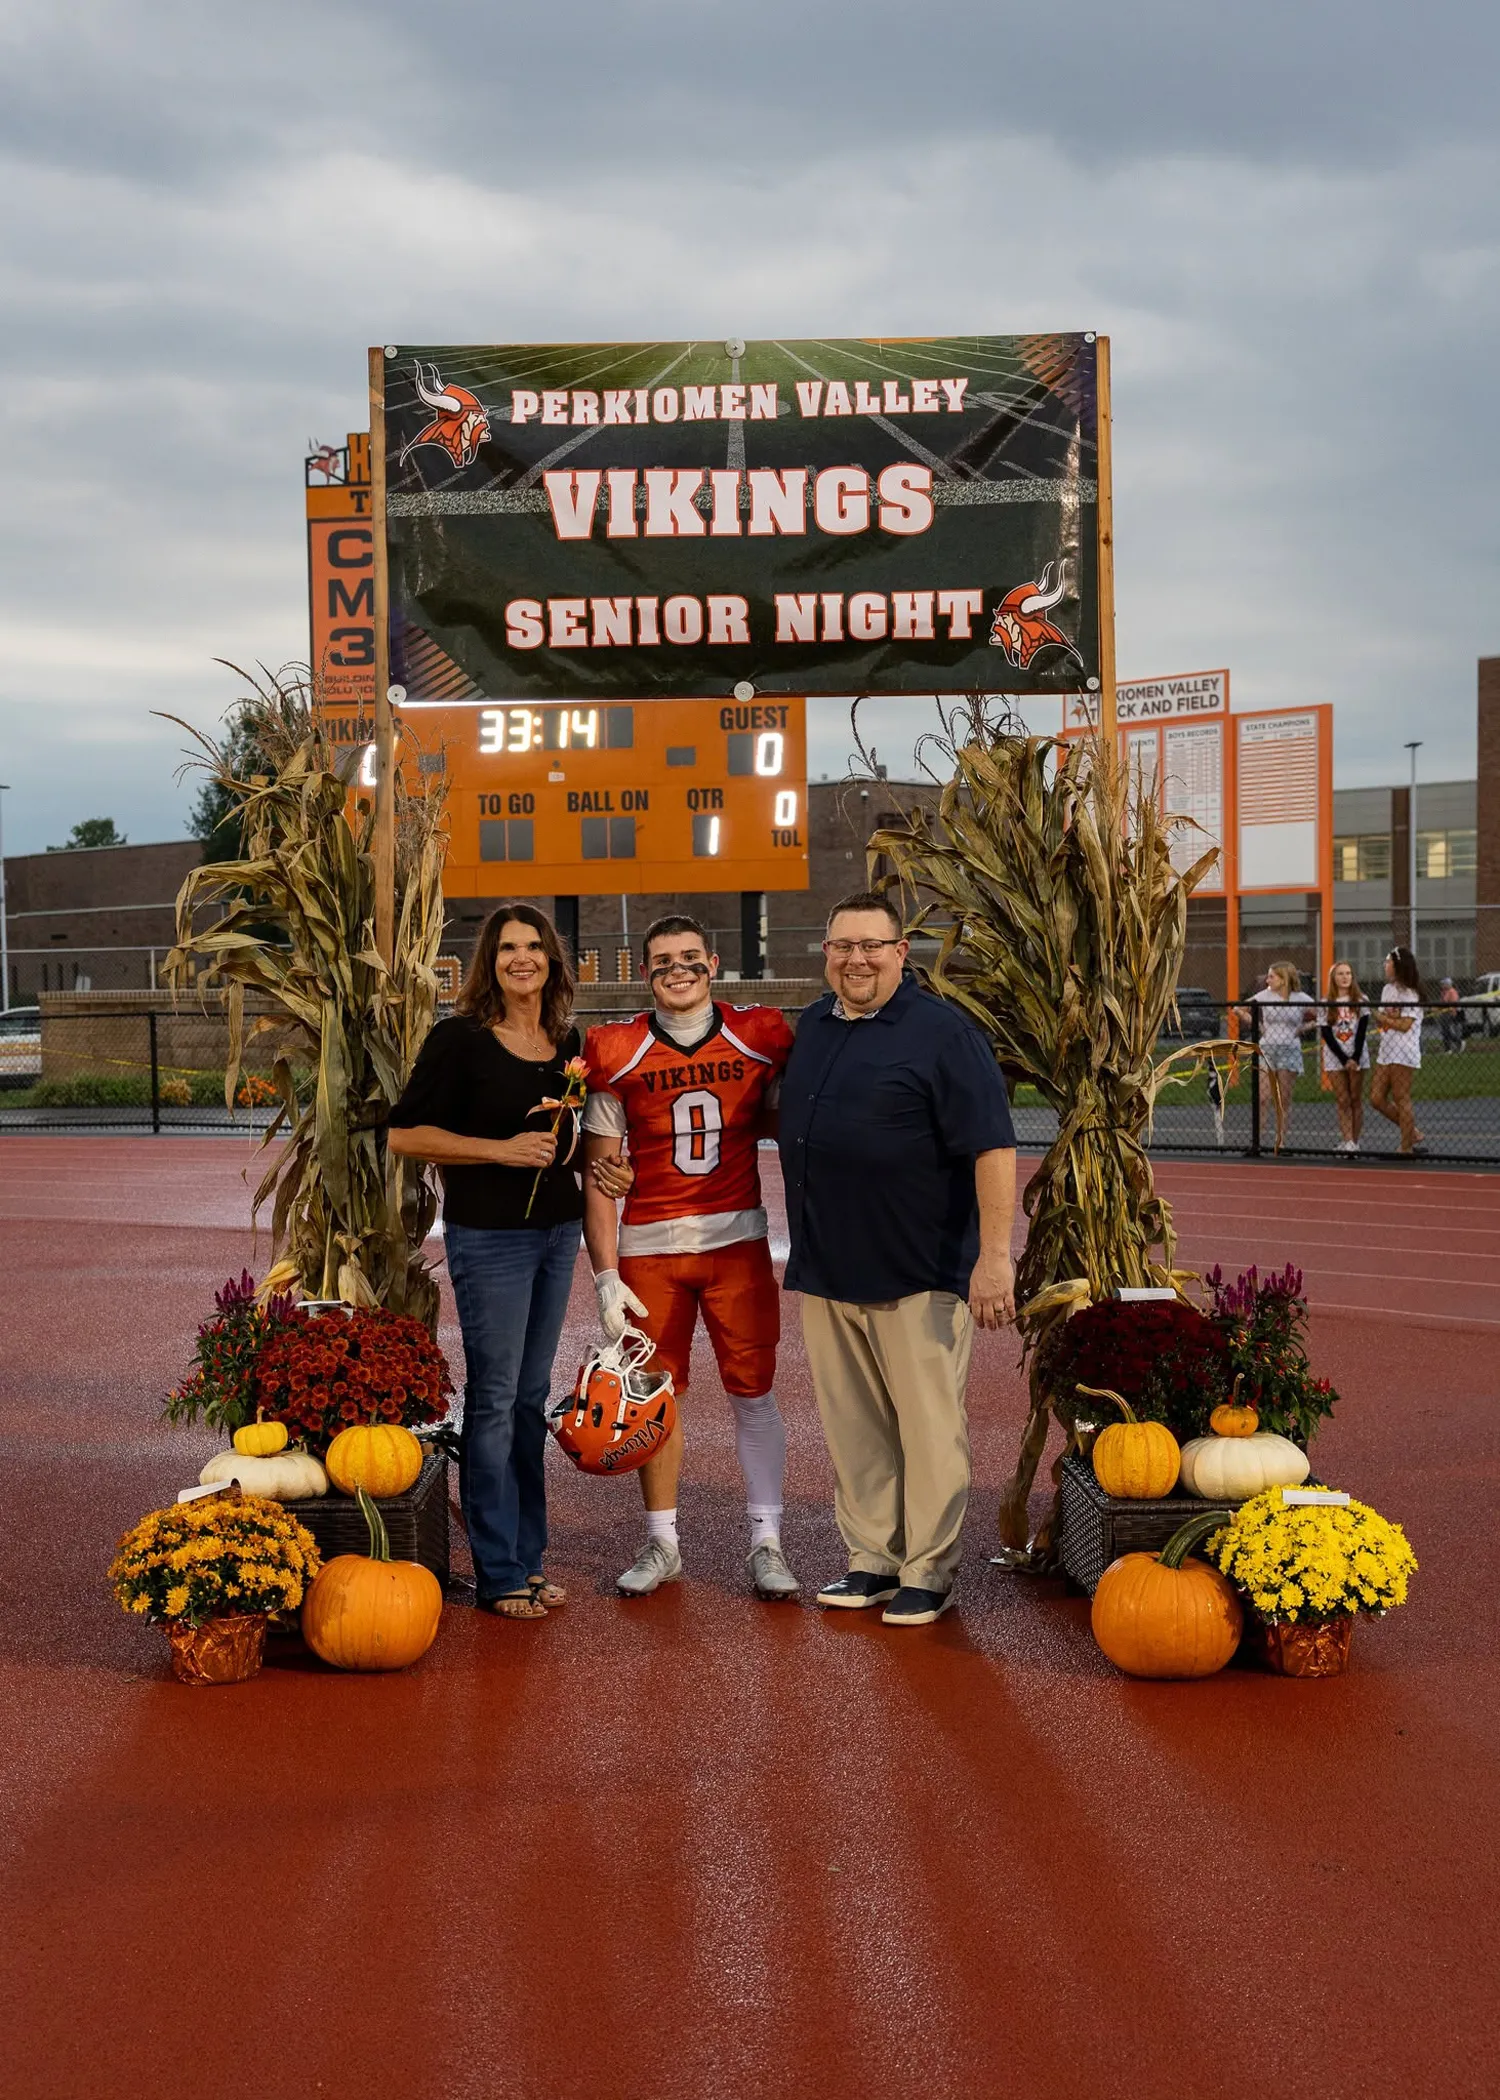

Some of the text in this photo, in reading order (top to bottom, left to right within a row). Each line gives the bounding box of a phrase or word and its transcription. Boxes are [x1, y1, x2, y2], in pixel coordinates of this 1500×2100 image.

[510, 377, 969, 426] PERKIOMEN VALLEY
[542, 464, 936, 541] VIKINGS
[504, 588, 983, 650] SENIOR NIGHT
[1168, 677, 1220, 697] VALLEY
[720, 706, 789, 730] GUEST
[1089, 693, 1220, 721] TCK AND FIELD
[479, 709, 597, 753] 33:14
[1168, 728, 1218, 739] BOYS RECORDS
[1246, 718, 1310, 731] STATE CHAMPIONS
[755, 732, 783, 776] 0
[478, 793, 535, 815] TO GO
[567, 790, 649, 812] BALL ON
[687, 788, 723, 810] QTR
[775, 790, 797, 827] 0
[709, 816, 720, 855] 1
[771, 829, 802, 848] TOL
[640, 1060, 745, 1093] VIKINGS
[599, 1418, 666, 1467] Vikings
